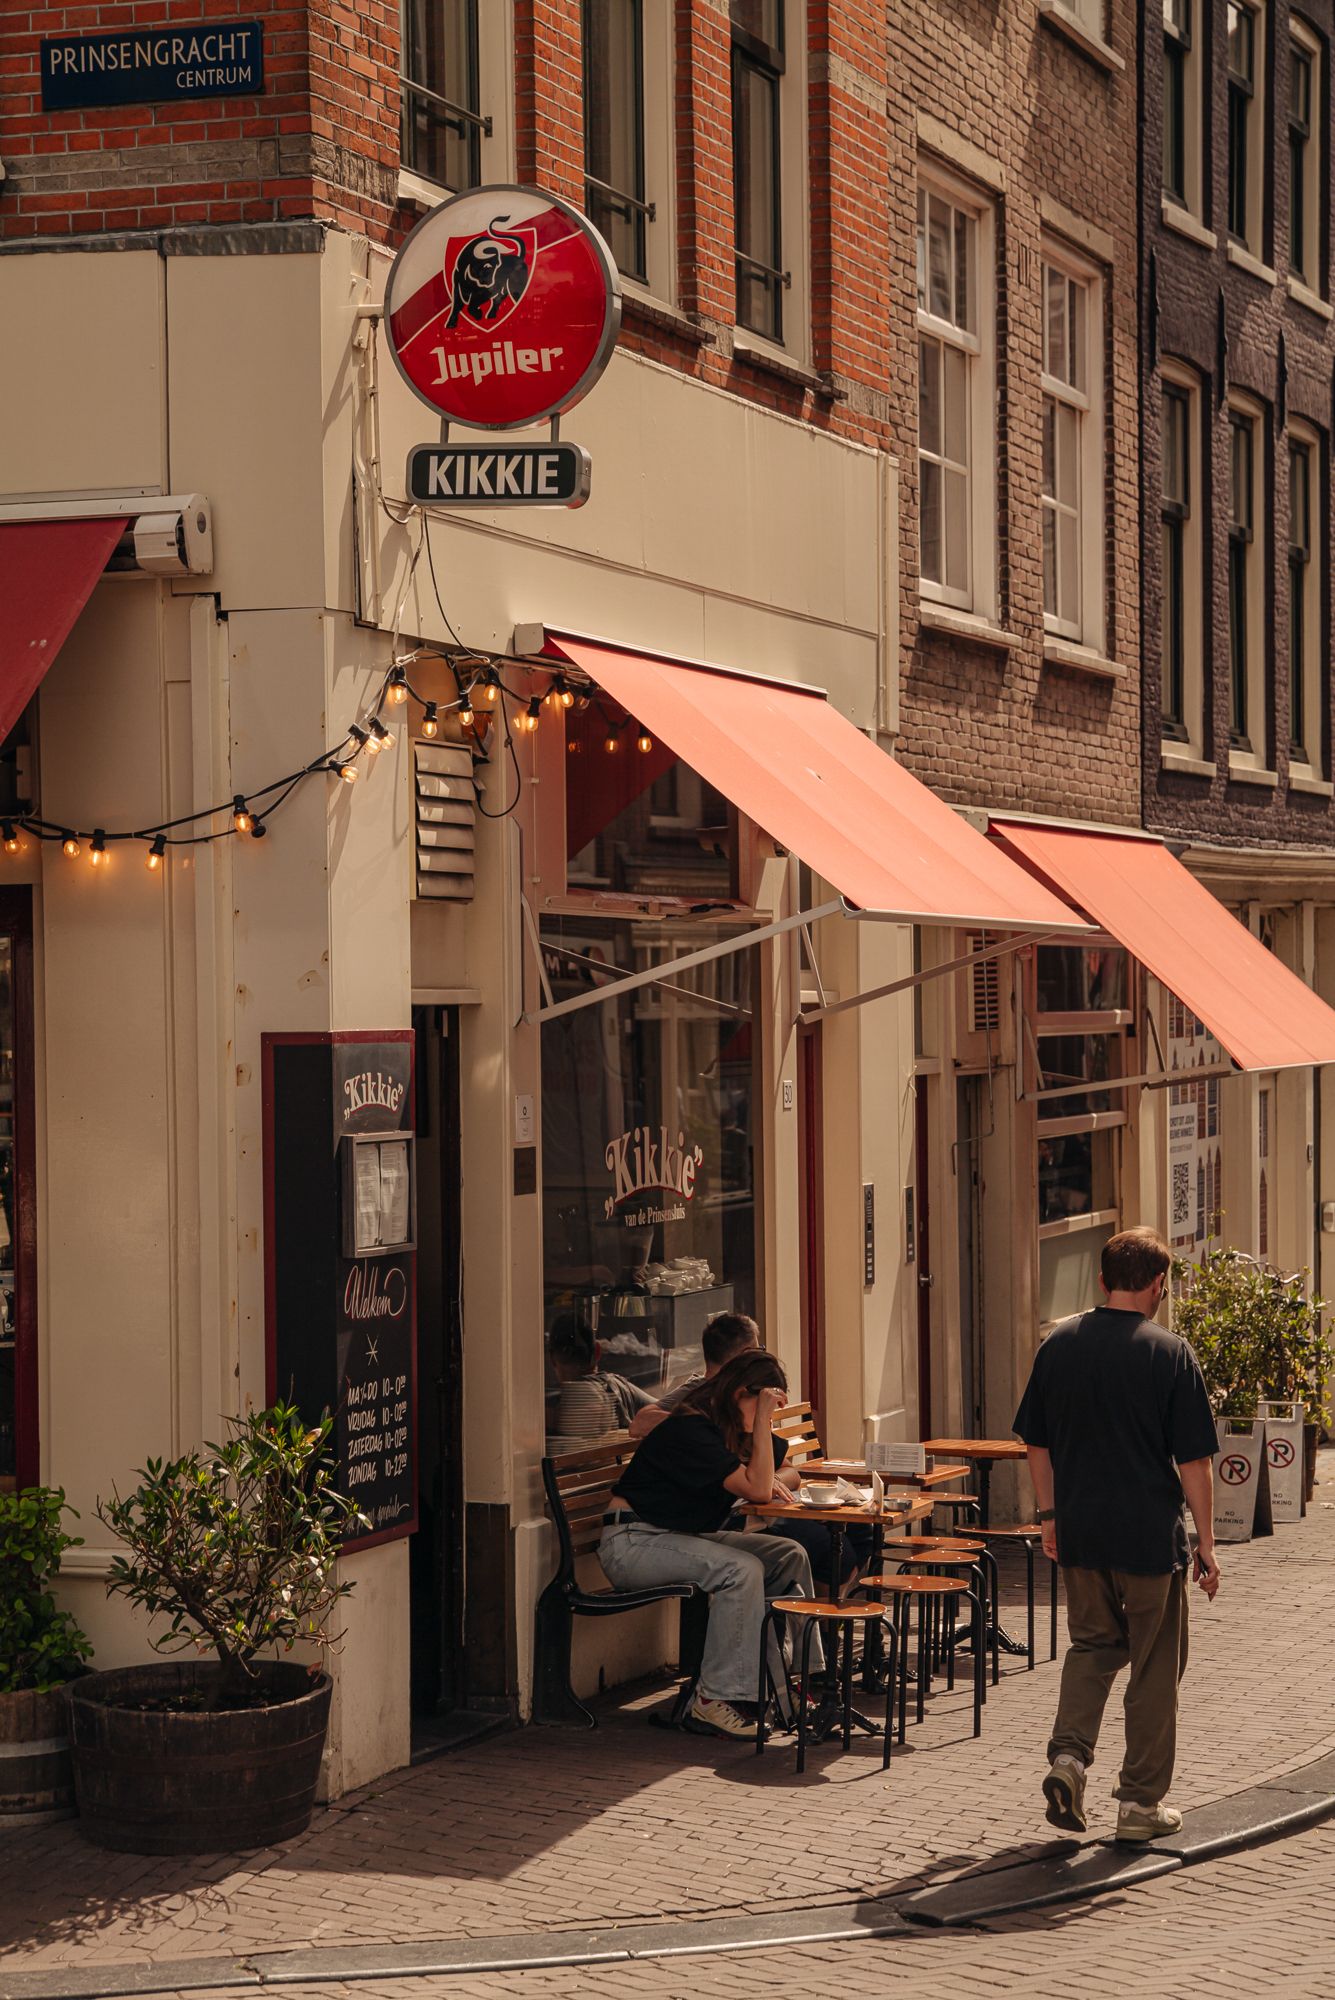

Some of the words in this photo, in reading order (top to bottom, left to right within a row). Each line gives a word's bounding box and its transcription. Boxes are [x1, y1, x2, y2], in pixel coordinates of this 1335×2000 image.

[50, 32, 251, 75] PRINSENGRACHT
[176, 65, 251, 88] CENTRUM
[429, 341, 564, 386] Jupiler
[428, 454, 560, 495] KIKKIE
[625, 1213, 637, 1227] van
[638, 1208, 646, 1225] de
[344, 1258, 407, 1320] Welkom
[348, 1433, 383, 1461] ZATERDAG
[348, 1461, 377, 1489] ZONDAG
[1214, 1517, 1244, 1525] PARKING
